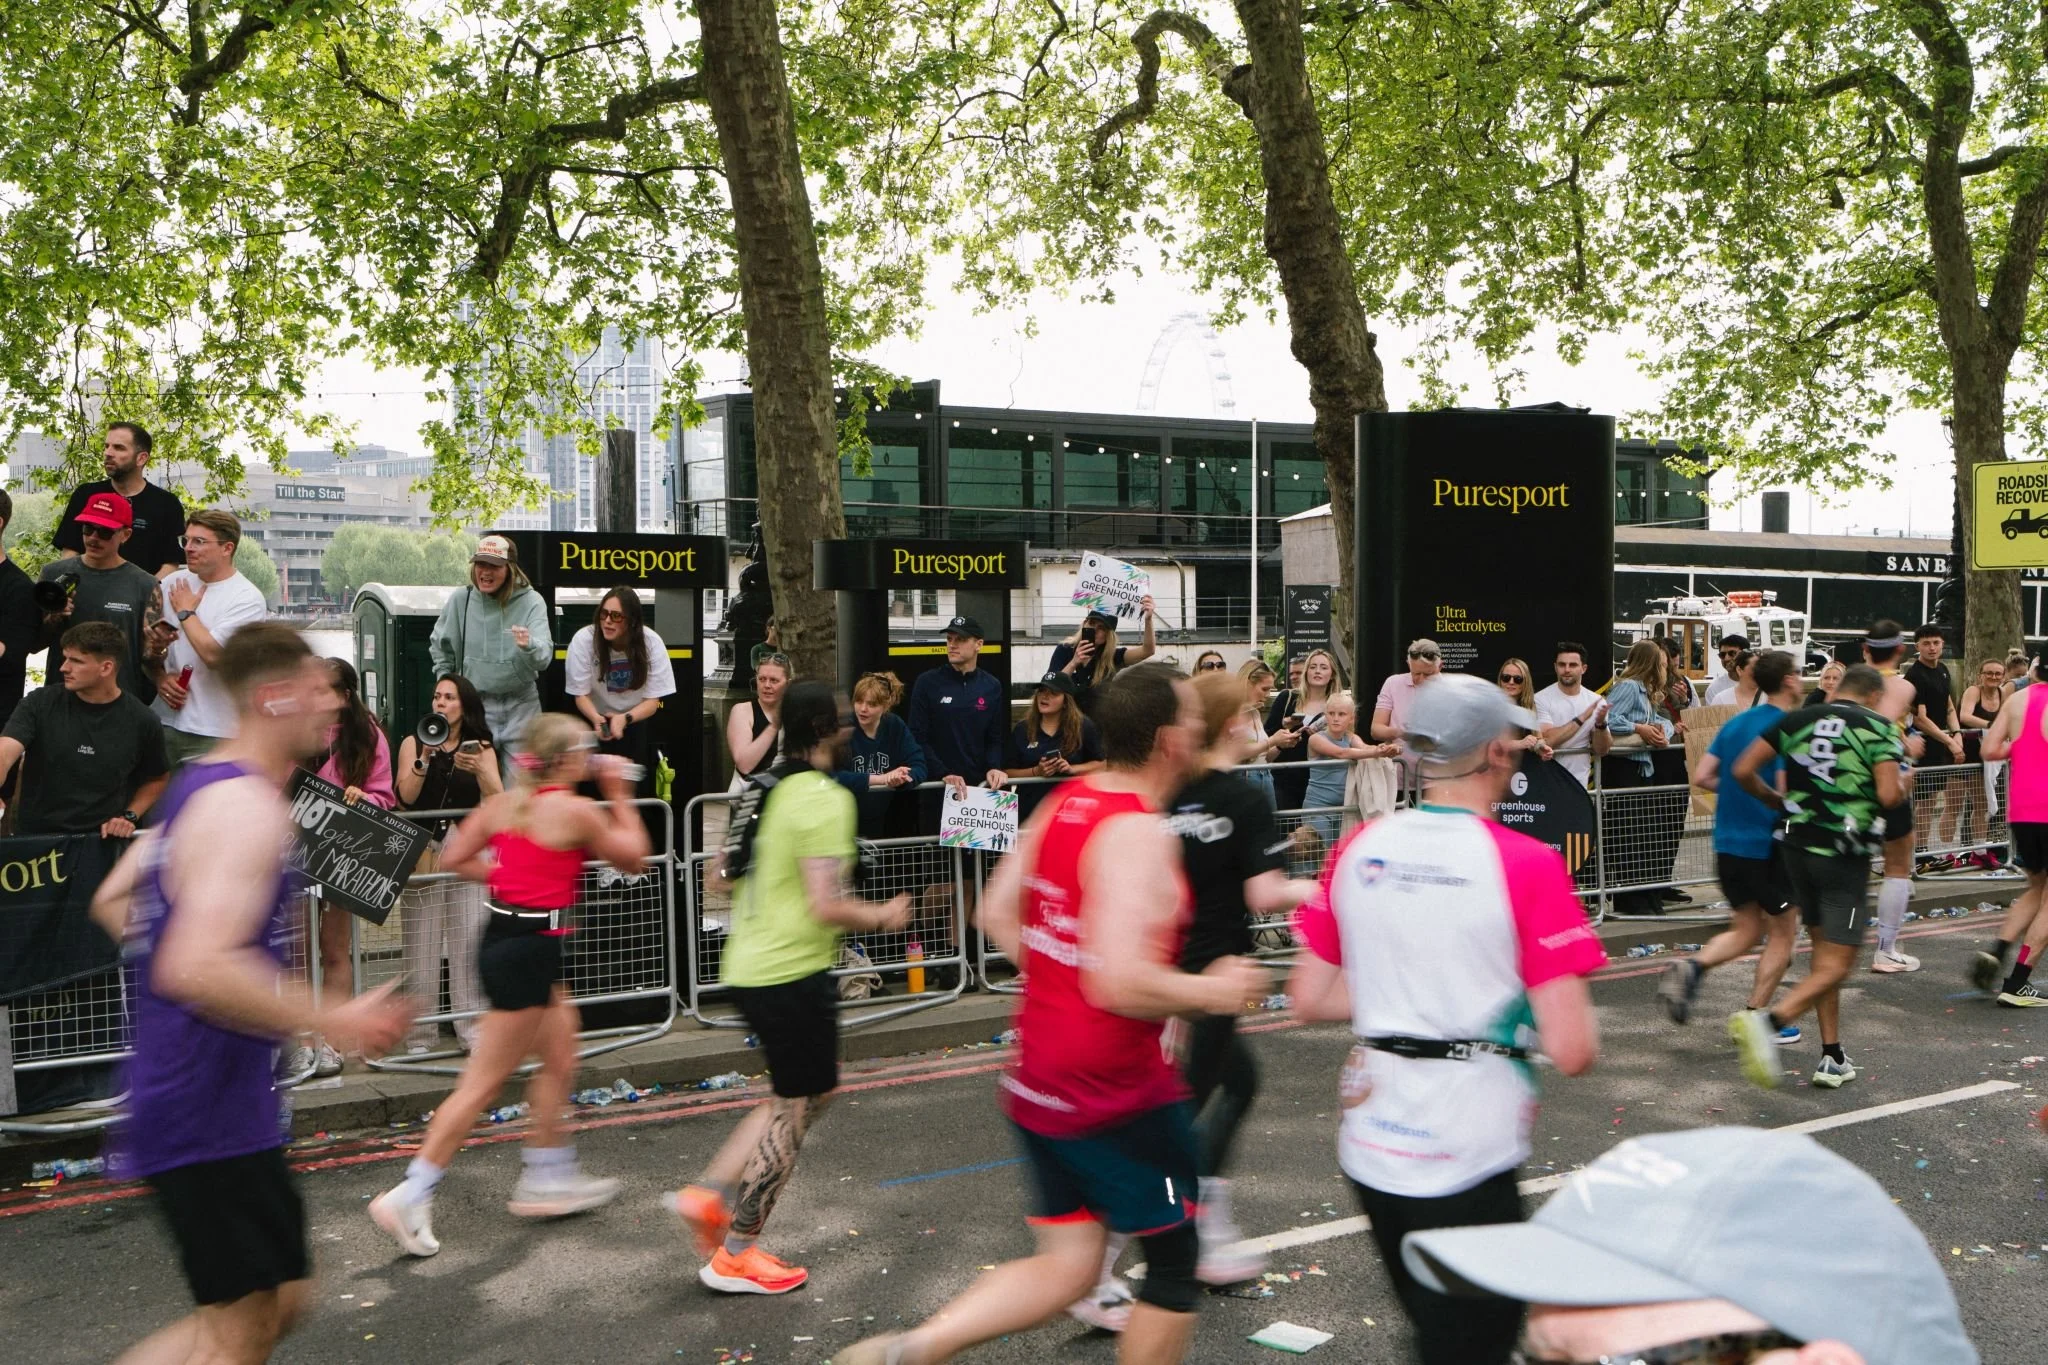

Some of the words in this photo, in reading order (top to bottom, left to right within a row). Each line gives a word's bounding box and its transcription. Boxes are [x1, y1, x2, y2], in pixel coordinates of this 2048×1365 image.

[277, 486, 294, 497] Till
[302, 487, 315, 498] the
[1433, 479, 1570, 514] Puresport
[559, 542, 697, 578] Puresport
[893, 548, 1007, 581] Puresport
[1094, 574, 1110, 584] GO
[1112, 578, 1139, 593] TEAM
[1436, 605, 1467, 618] Ultra
[1436, 619, 1506, 635] Electrolytes
[853, 751, 890, 775] GAP
[1808, 718, 1846, 785] APB
[304, 776, 337, 797] FASTER.
[383, 815, 418, 837] ADIZERO
[961, 807, 978, 817] GO
[981, 808, 1007, 821] TEAM
[1491, 800, 1546, 812] greenhouse
[1502, 812, 1534, 824] sports
[288, 789, 348, 836] HOT
[318, 829, 381, 861] girls
[948, 816, 1015, 833] GREENHOUSE
[0, 848, 68, 892] ort
[315, 847, 400, 910] MARATHONS
